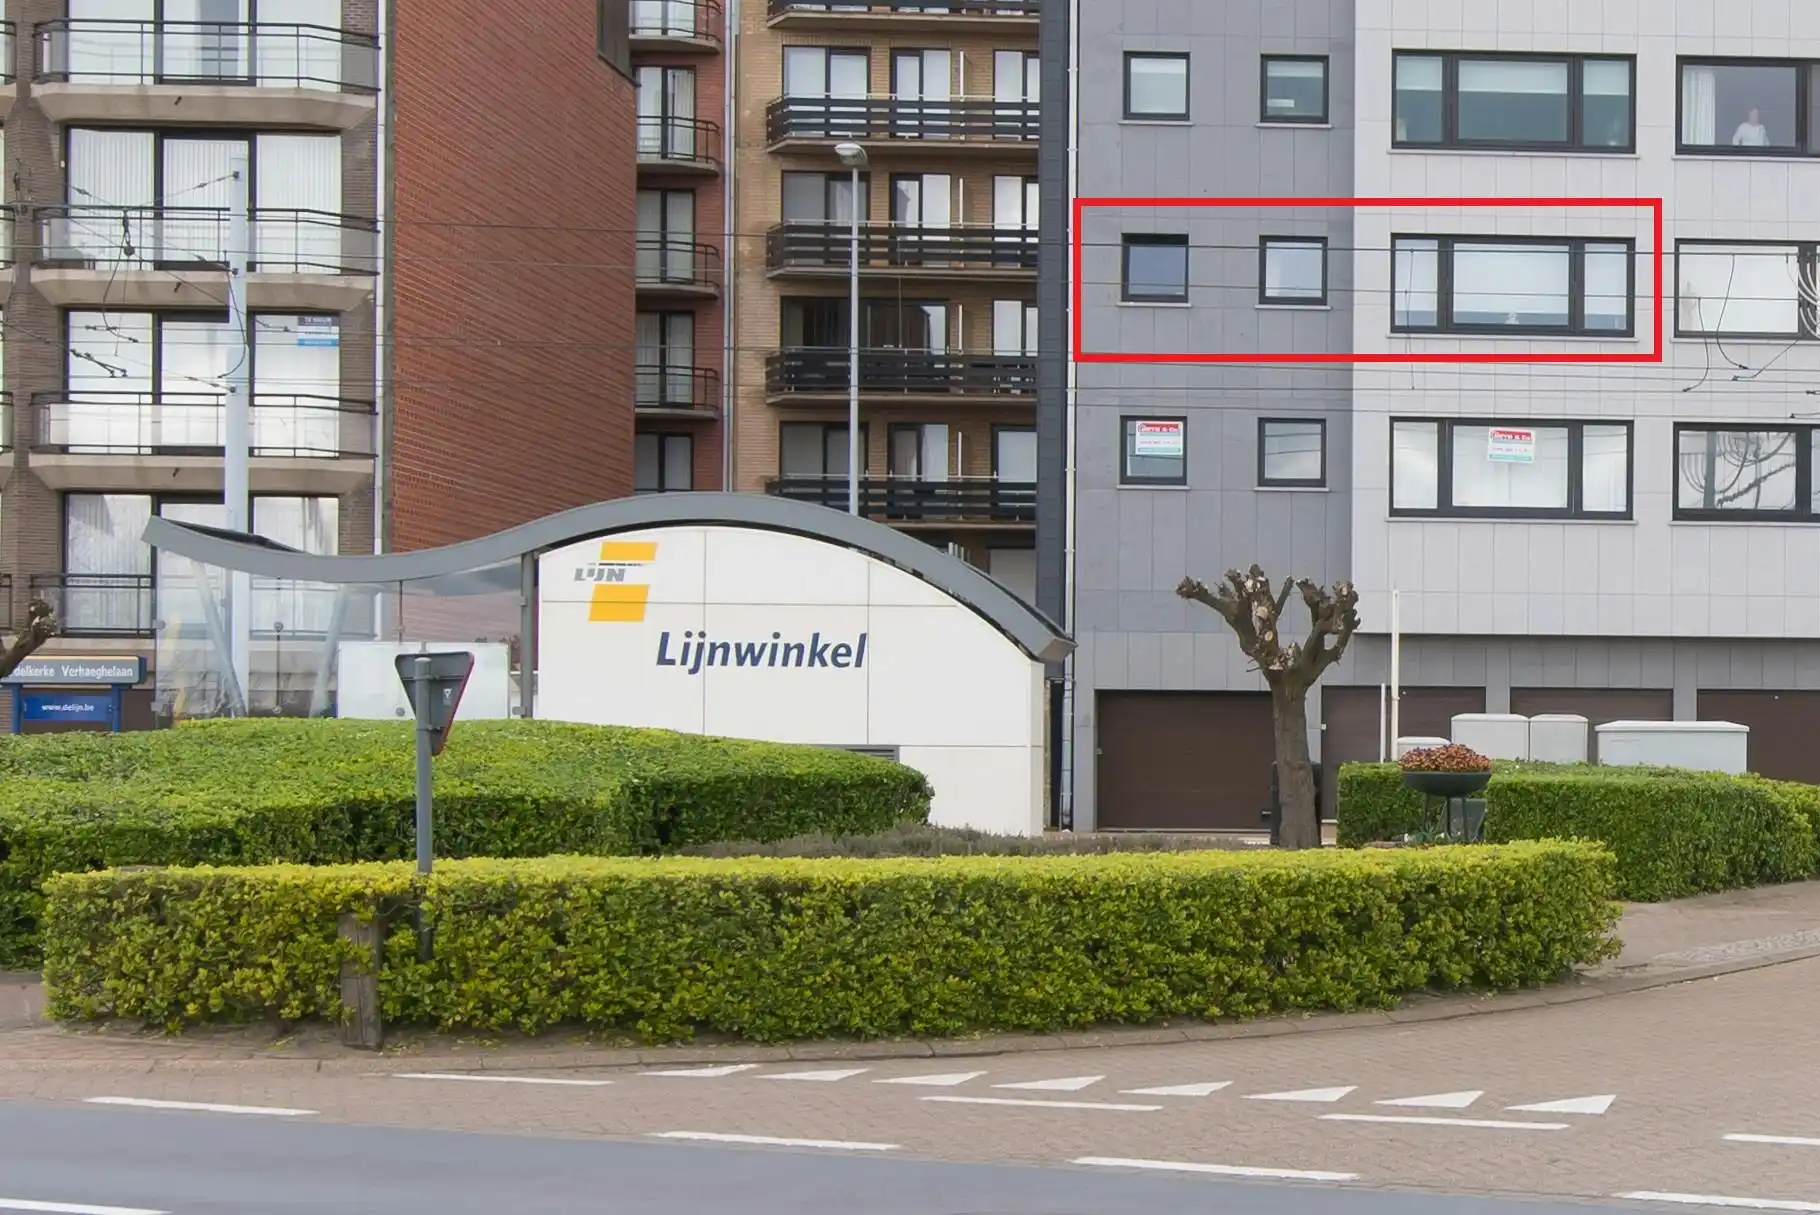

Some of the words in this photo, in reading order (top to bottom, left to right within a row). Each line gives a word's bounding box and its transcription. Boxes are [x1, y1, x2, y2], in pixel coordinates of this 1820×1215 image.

[656, 631, 868, 675] Lijnwinkel
[14, 665, 55, 677] delkerke
[61, 664, 133, 679] Verhaeghelaan
[42, 704, 95, 713] www.delijn.be
